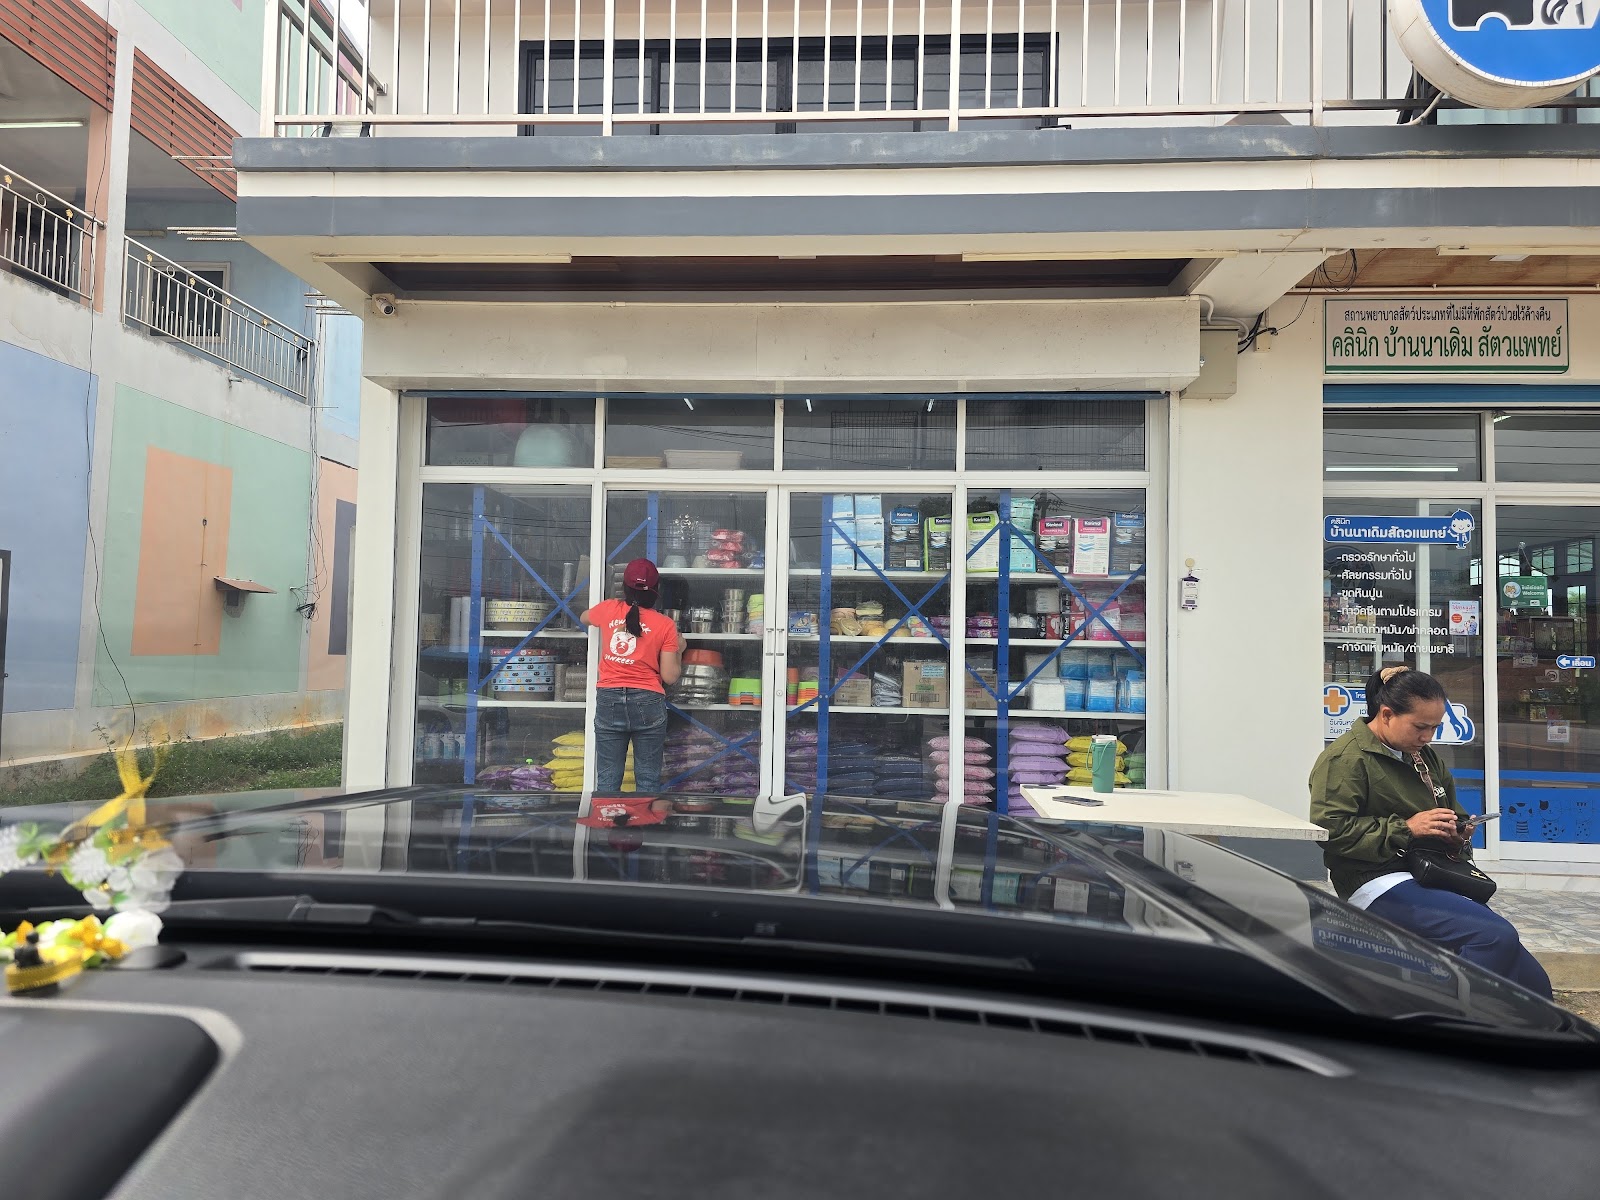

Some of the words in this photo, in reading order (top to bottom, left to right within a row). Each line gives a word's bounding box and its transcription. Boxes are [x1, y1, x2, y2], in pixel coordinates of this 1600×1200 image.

[1332, 327, 1379, 357] คลินิก
[1384, 326, 1473, 357] บ้านนาเดิม
[1478, 325, 1562, 357] สัตวแพทย์
[1330, 525, 1447, 538] บ้านนาเดิมสัตวแพทย์
[1336, 549, 1416, 562] -ตรวจรักษาทั่วไป
[1336, 567, 1412, 580] -ศัลยกรรมทั่วไป
[1336, 588, 1383, 601] -ขูดหินปูน
[608, 619, 626, 628] NEW
